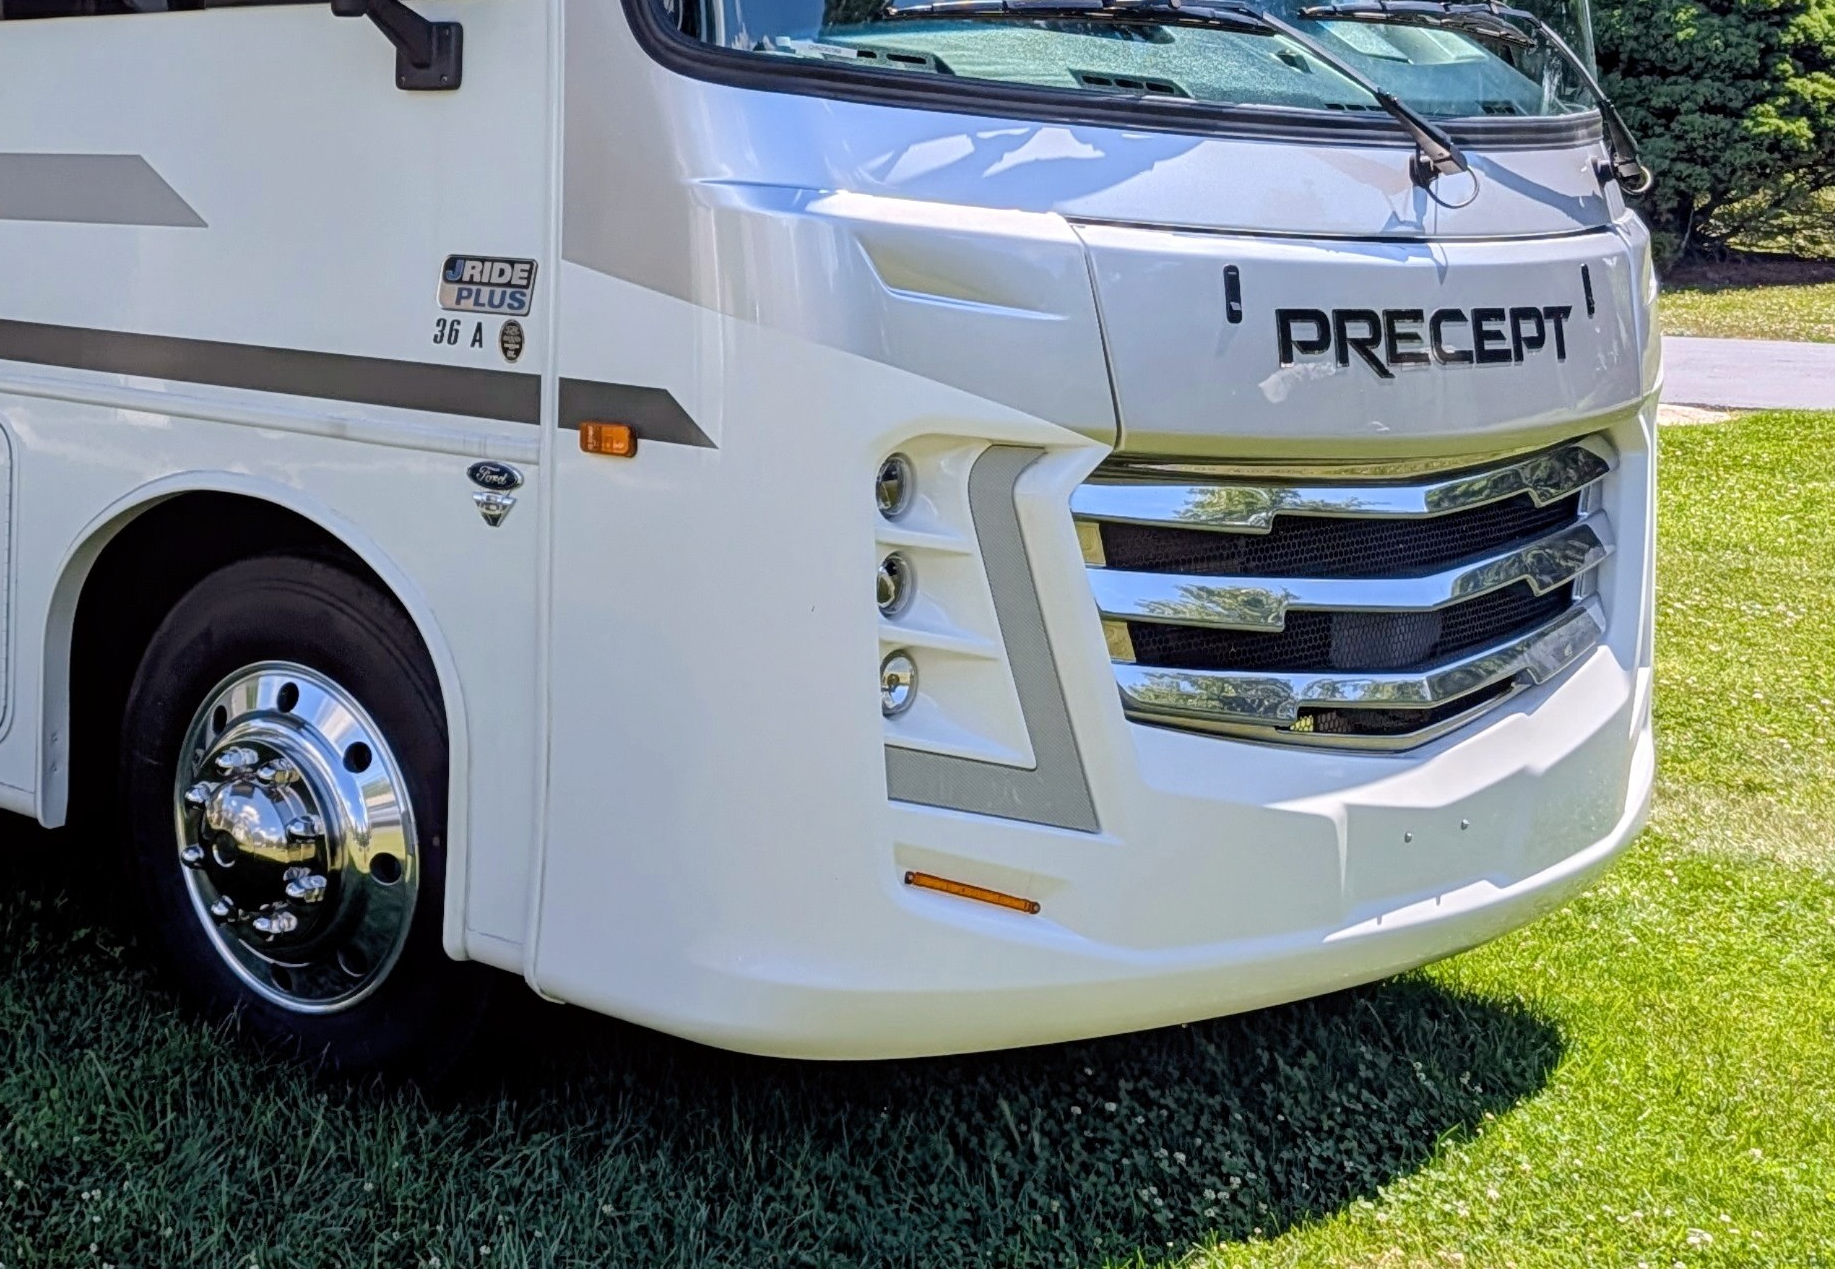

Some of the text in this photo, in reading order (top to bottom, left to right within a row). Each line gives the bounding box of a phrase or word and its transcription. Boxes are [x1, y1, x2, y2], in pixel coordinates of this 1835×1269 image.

[454, 286, 527, 311] PLUS
[433, 317, 462, 346] 36
[469, 321, 484, 349] A
[1275, 305, 1573, 379] PRECEPT
[476, 465, 509, 485] Ford
